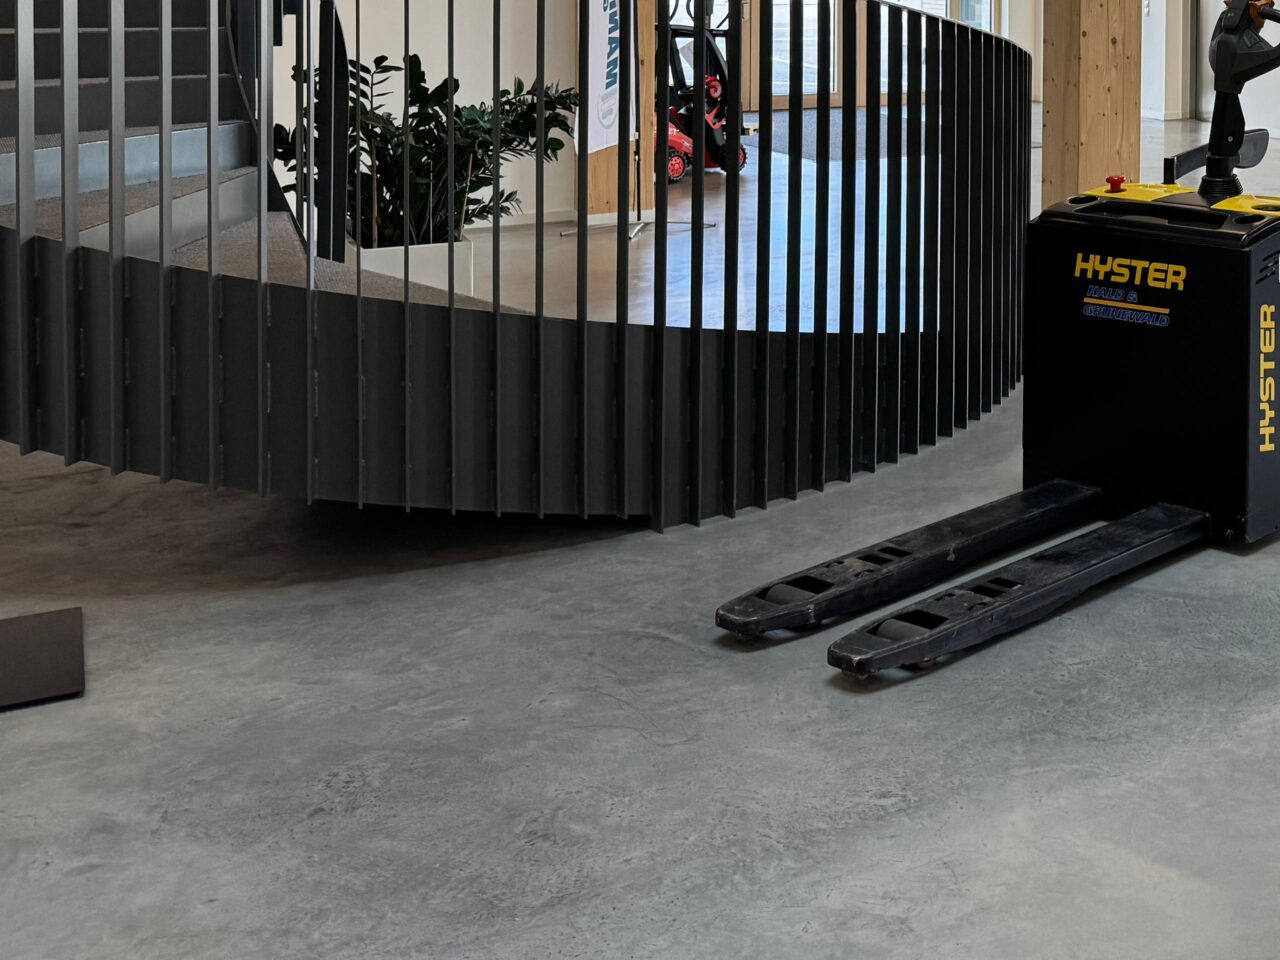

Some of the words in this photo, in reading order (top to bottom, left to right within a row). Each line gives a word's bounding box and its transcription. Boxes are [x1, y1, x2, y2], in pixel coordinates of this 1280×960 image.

[1074, 252, 1187, 291] HYSTER
[1086, 285, 1125, 300] HALD
[1127, 291, 1138, 303] &
[1083, 304, 1170, 327] GRUNEWALD
[1259, 303, 1276, 453] HYSTER
